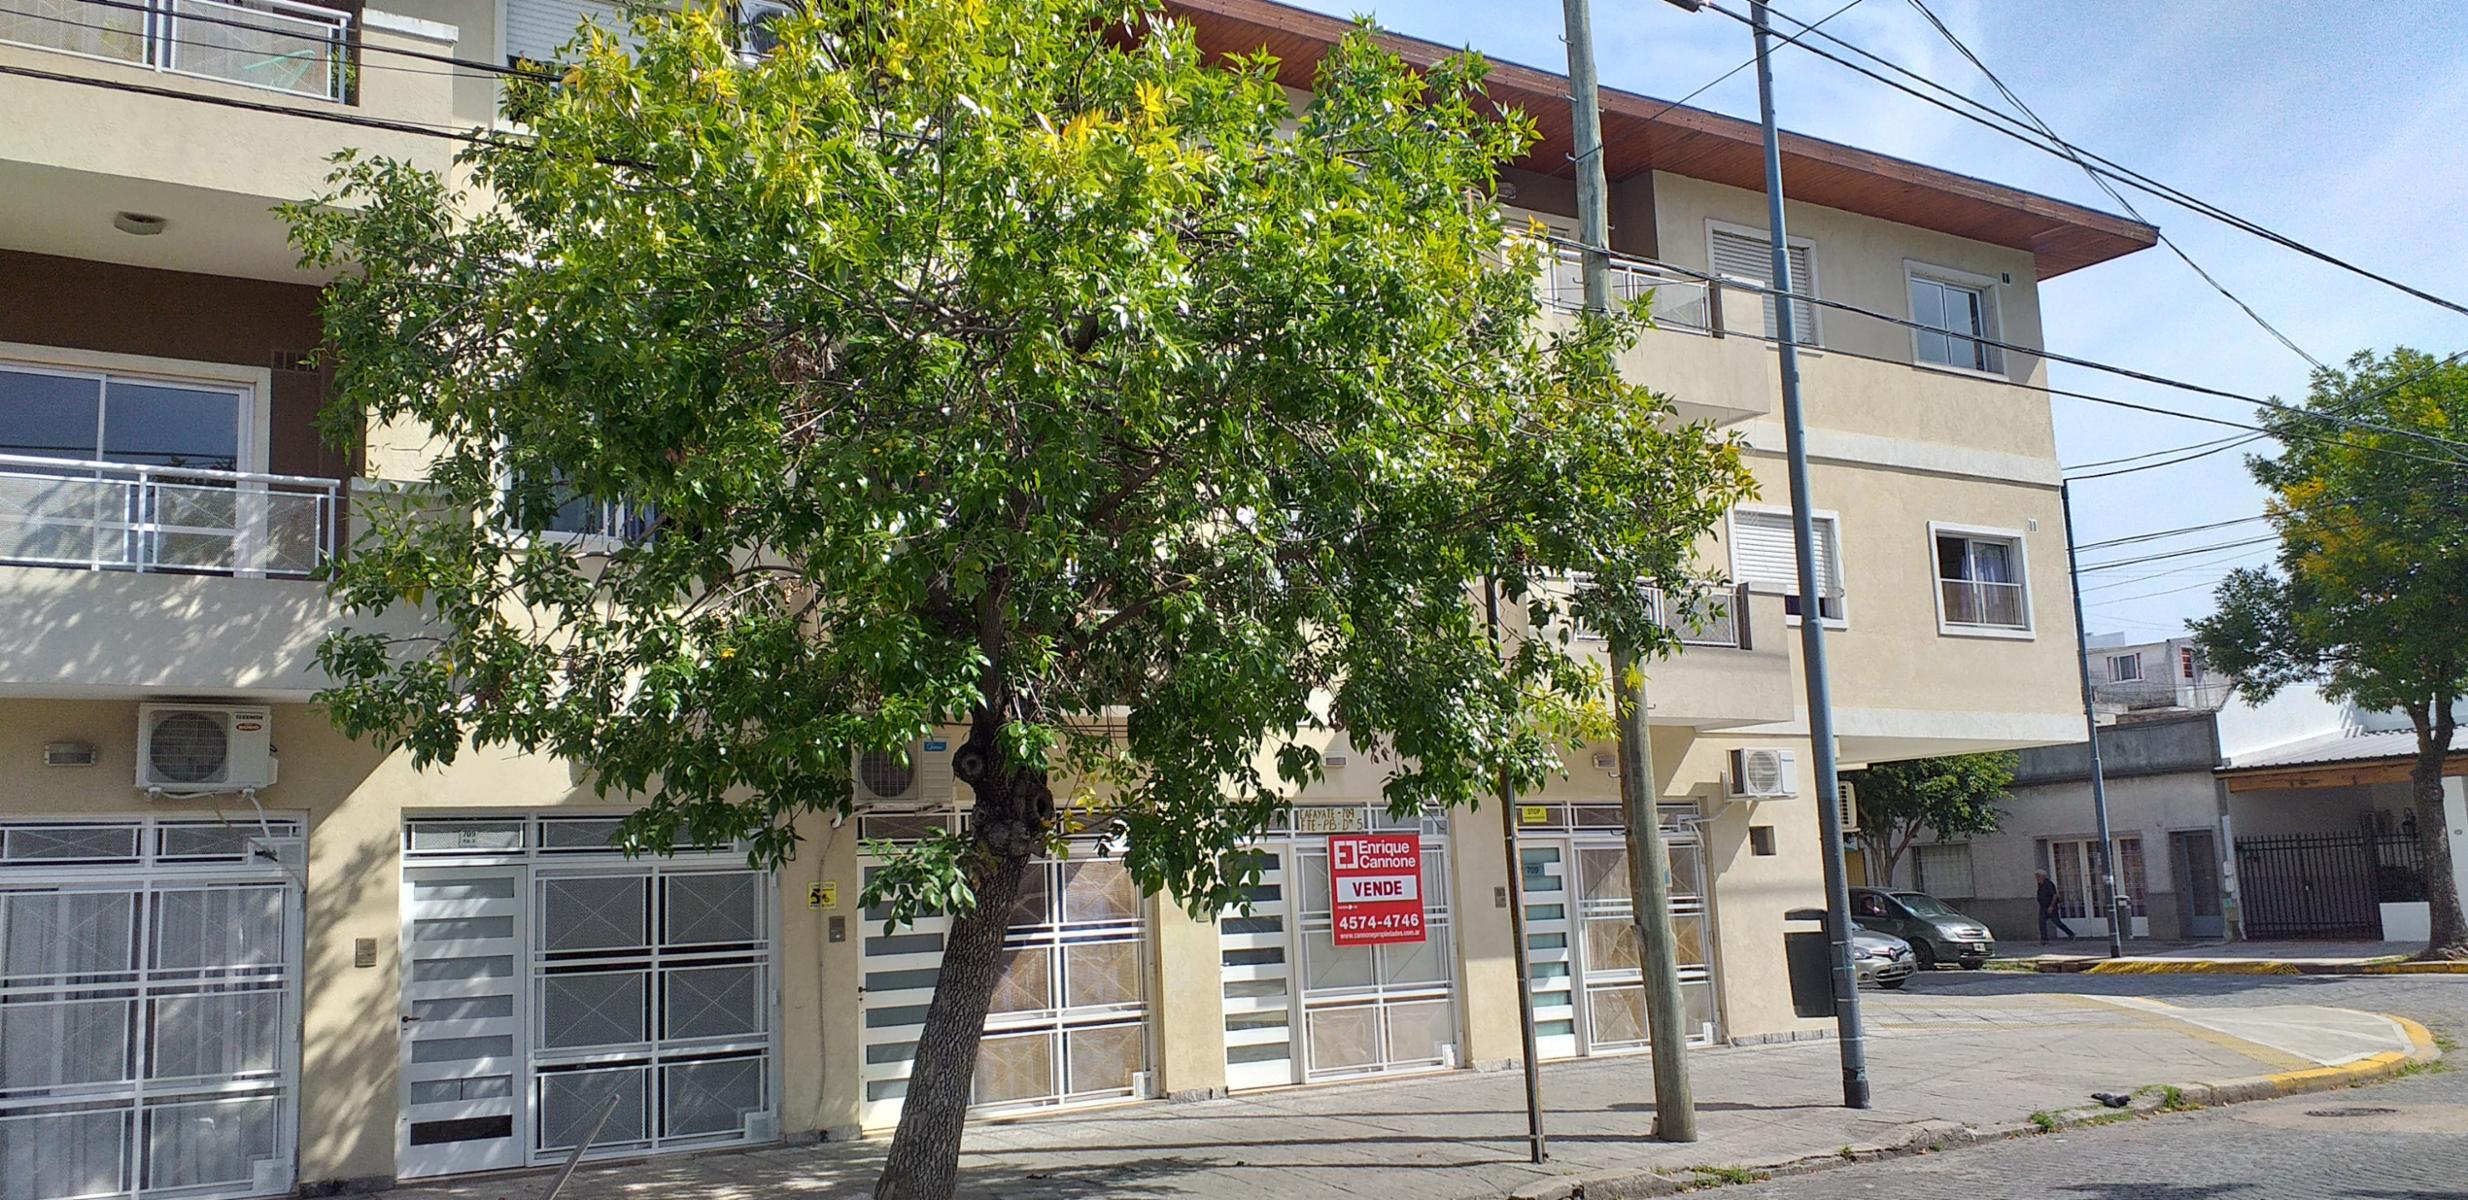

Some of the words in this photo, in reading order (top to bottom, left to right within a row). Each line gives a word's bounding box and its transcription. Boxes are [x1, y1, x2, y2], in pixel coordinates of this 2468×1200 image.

[1359, 840, 1410, 857] Enrique
[1360, 855, 1416, 869] Cannone
[1352, 880, 1403, 897] VENDE
[1339, 913, 1420, 930] 4574-4746
